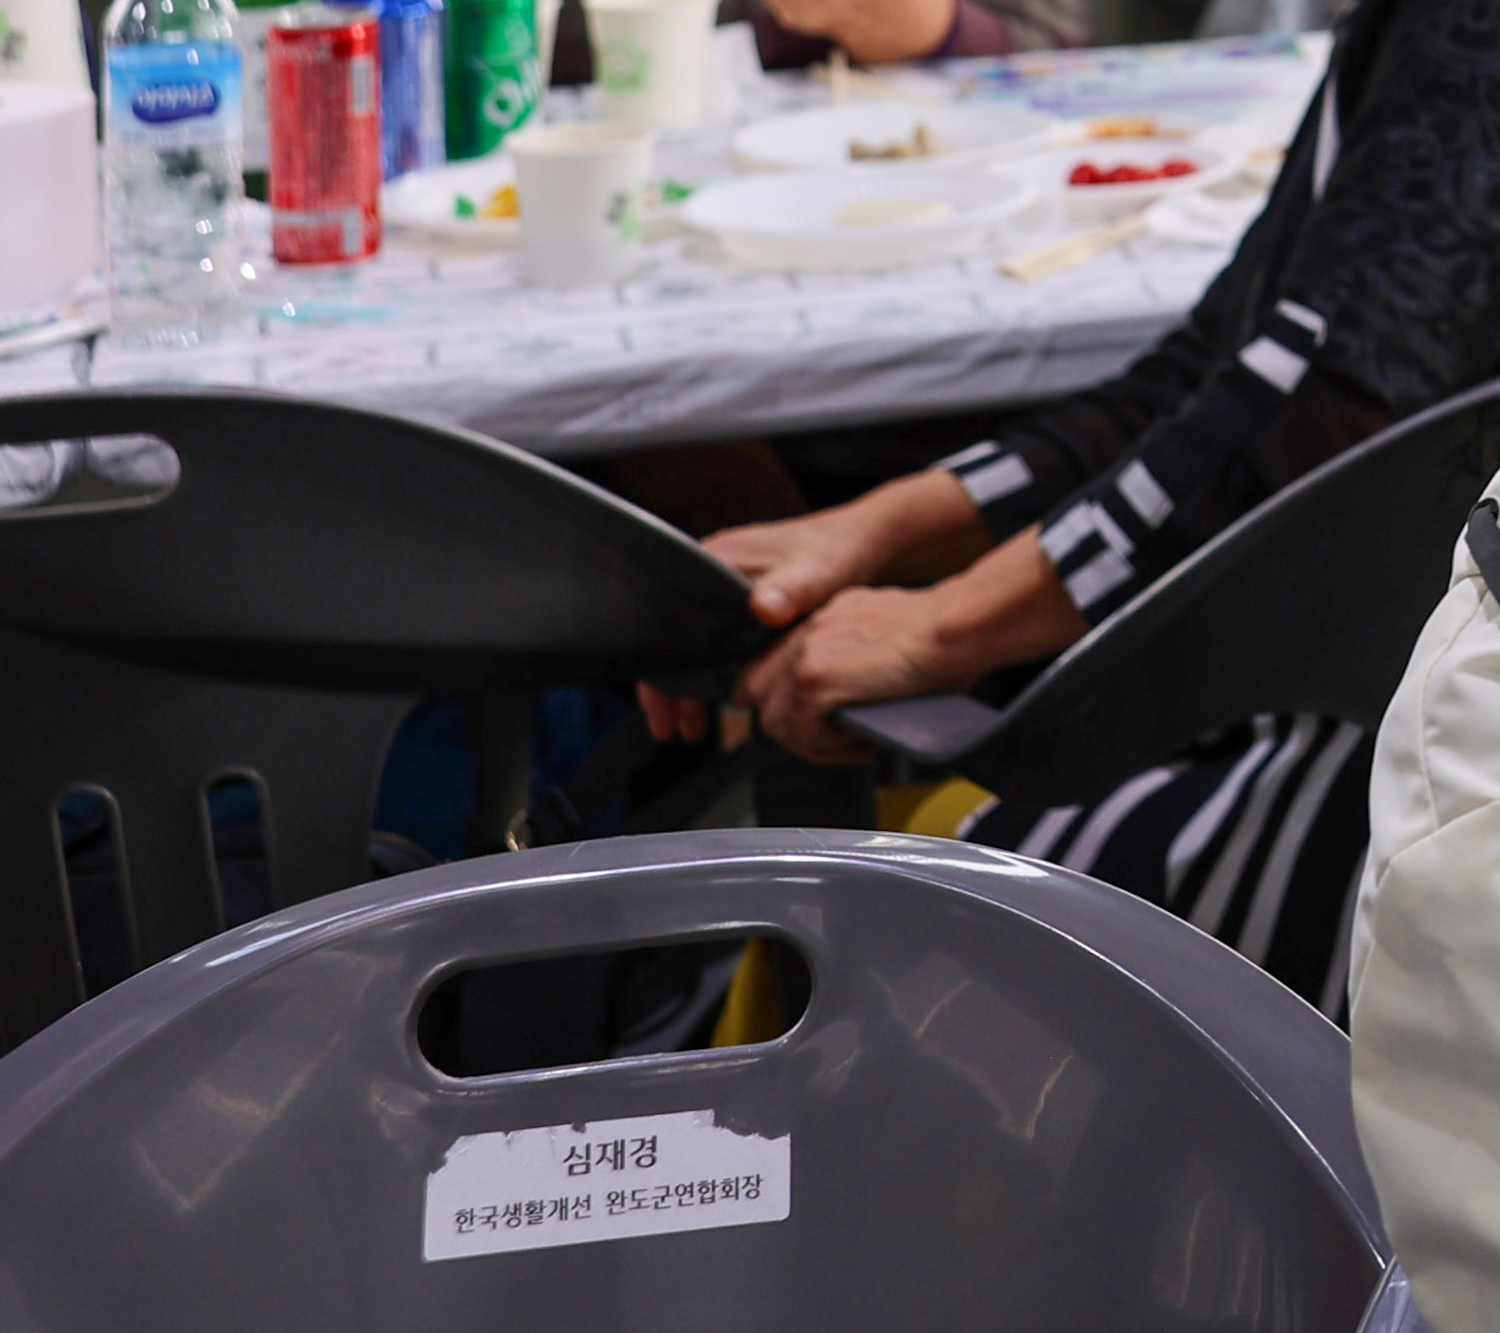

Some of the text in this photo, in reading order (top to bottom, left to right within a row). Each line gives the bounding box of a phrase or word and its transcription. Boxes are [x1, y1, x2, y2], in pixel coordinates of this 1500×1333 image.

[563, 1135, 659, 1177] 심재경
[454, 1173, 764, 1235] 한국생활개선 완도군연합회장
